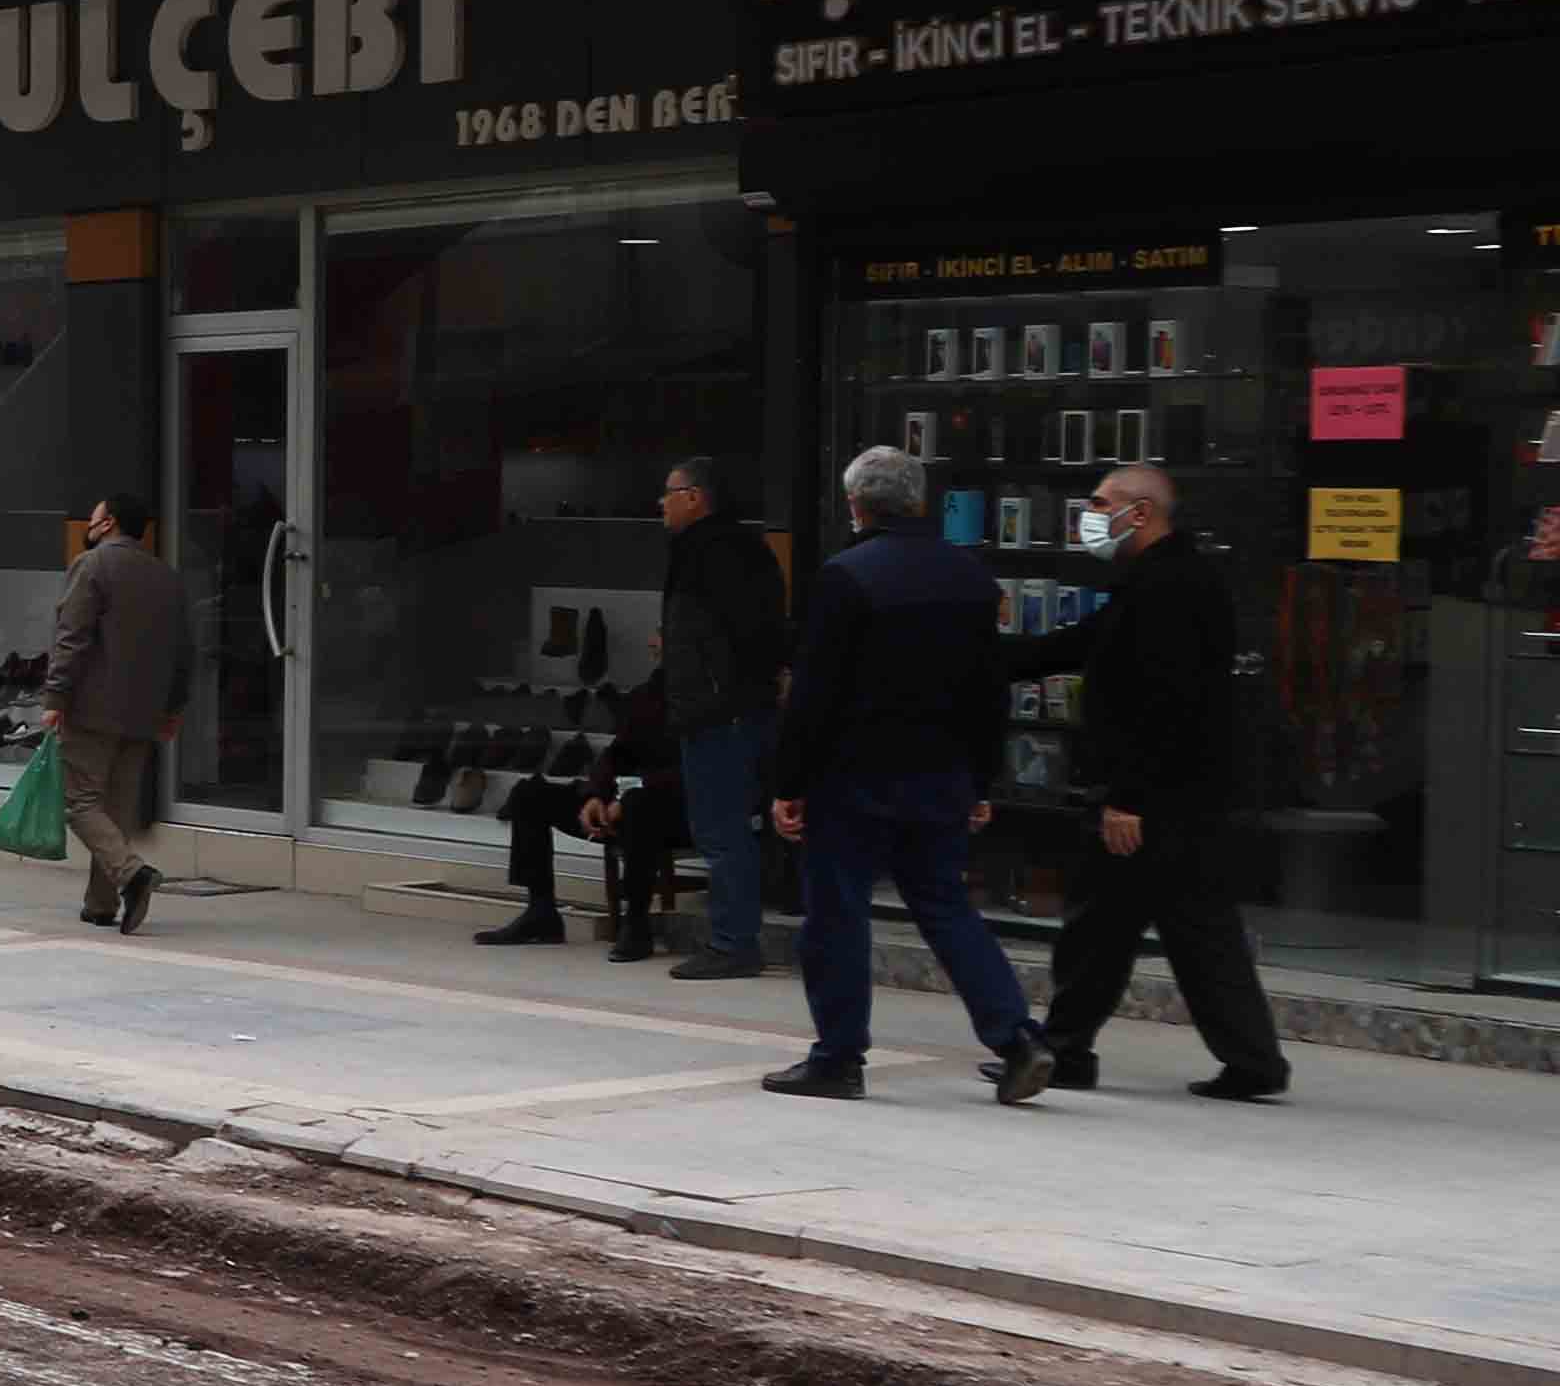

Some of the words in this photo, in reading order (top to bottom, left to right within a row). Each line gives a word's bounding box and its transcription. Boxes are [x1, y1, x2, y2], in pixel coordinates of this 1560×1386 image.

[775, 38, 862, 86] SIFIR
[894, 9, 1006, 74] İKİNCİ
[1013, 15, 1060, 56] EL
[456, 101, 544, 147] 1968
[555, 93, 640, 140] DEN
